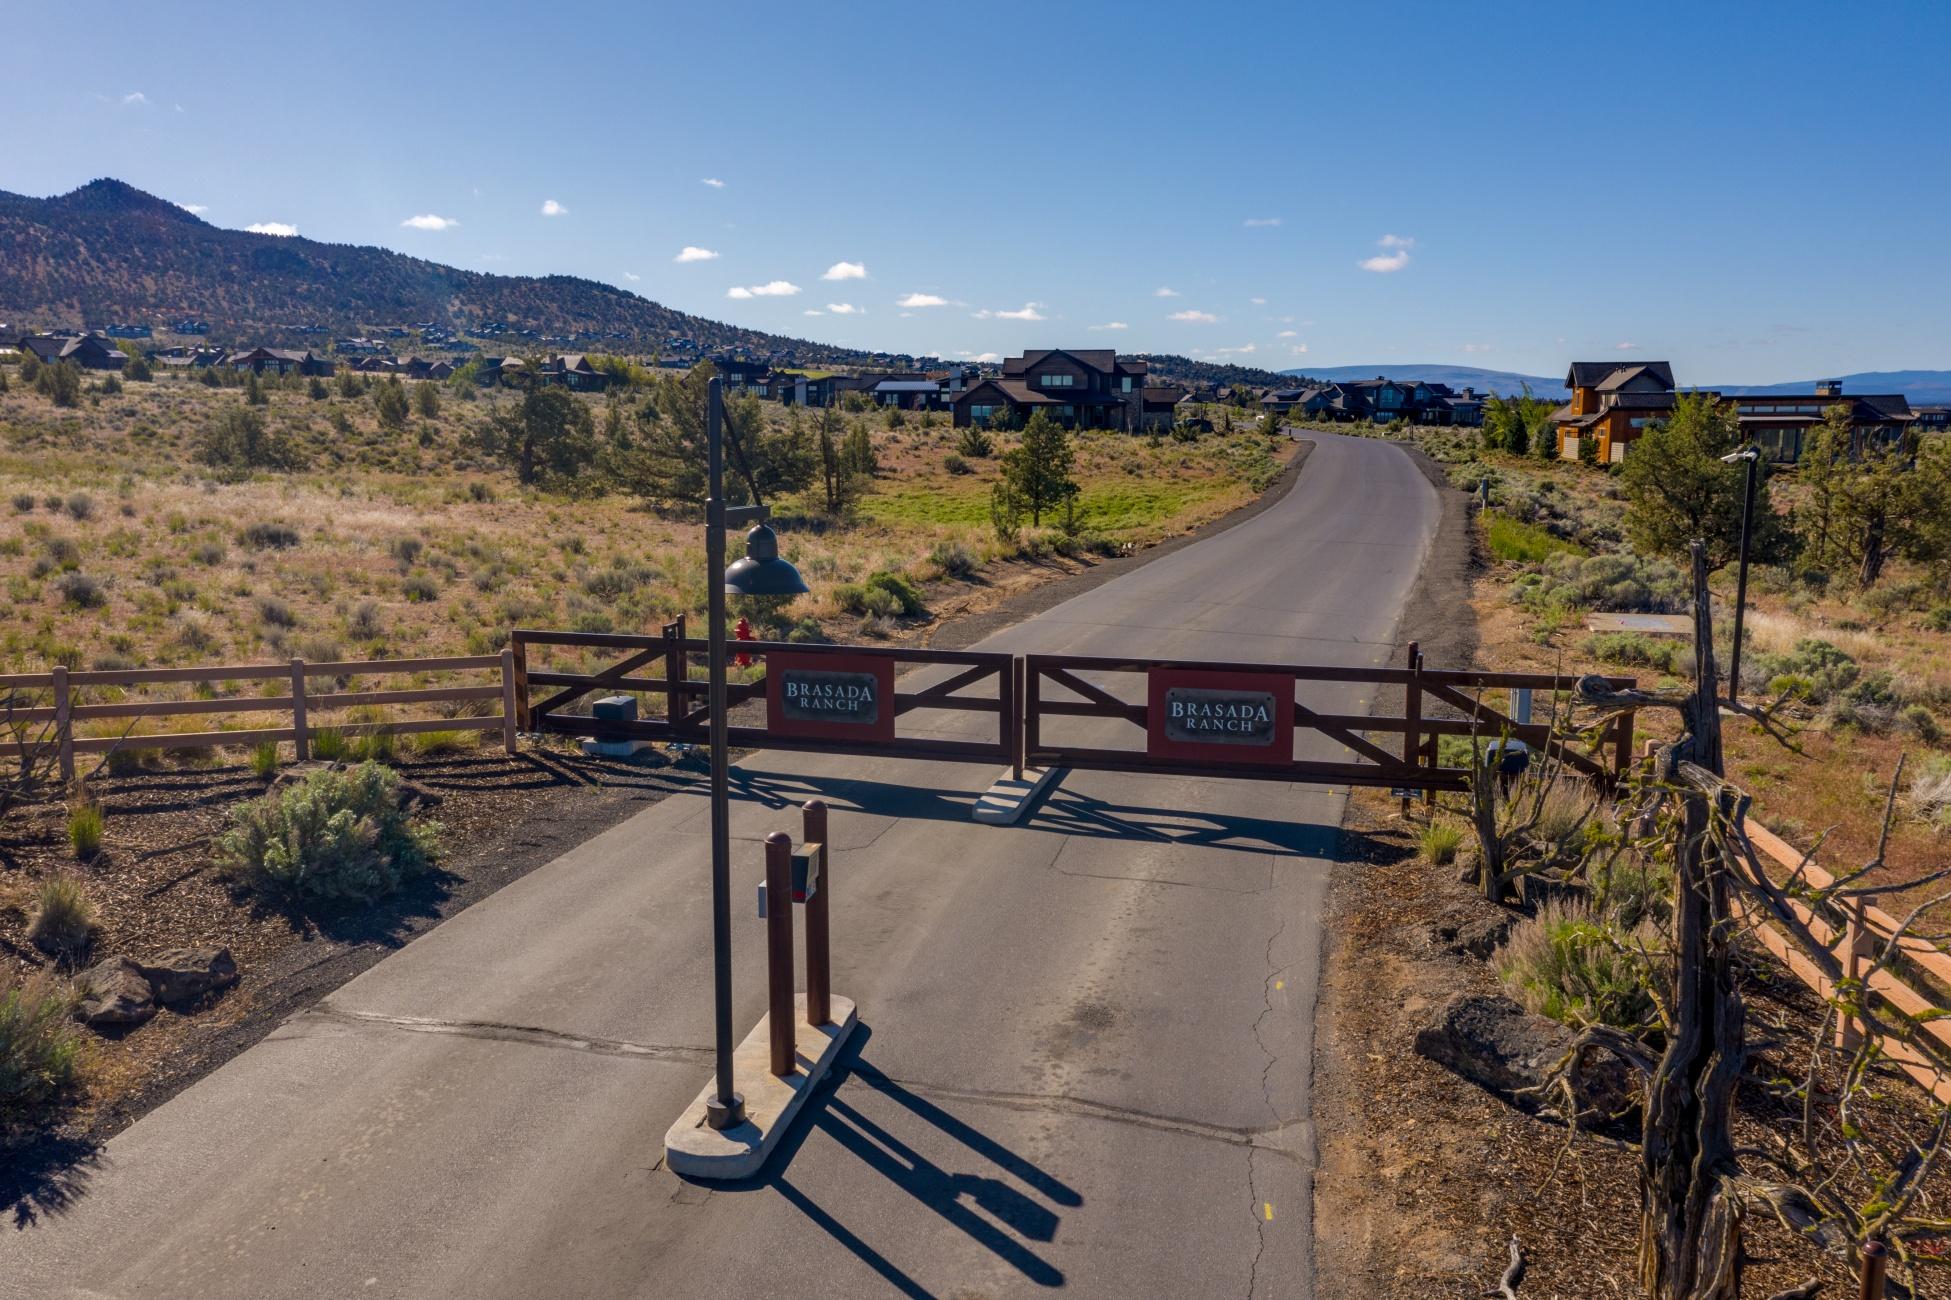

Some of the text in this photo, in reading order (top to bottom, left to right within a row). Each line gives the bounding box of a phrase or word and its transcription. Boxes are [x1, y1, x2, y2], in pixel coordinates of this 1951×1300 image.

[786, 682, 872, 701] BRASADA
[800, 698, 858, 711] RANCH
[1171, 702, 1270, 722] BRASADA
[1186, 718, 1253, 732] RANCH
